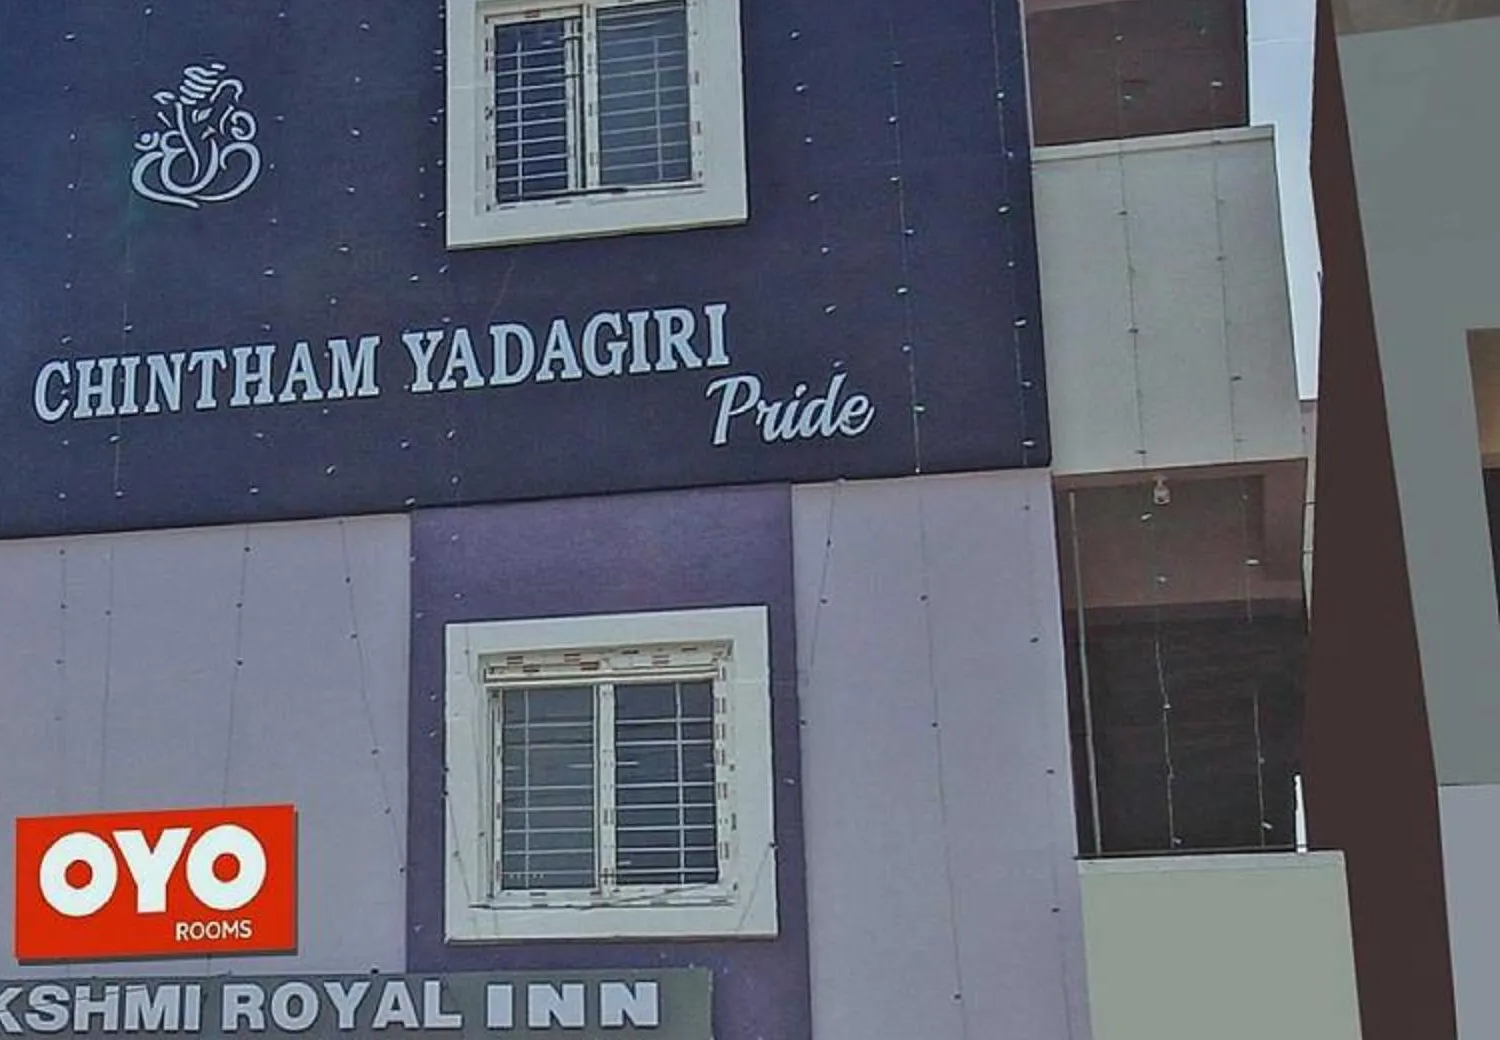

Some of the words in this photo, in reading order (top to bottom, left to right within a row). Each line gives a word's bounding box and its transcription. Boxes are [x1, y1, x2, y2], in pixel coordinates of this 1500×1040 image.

[34, 335, 381, 422] CHINTHAM
[403, 303, 730, 393] YADAGIRI
[705, 371, 875, 446] Pride
[38, 823, 268, 917] OYO
[175, 919, 253, 941] ROOMS
[222, 981, 462, 1033] ROYAL
[485, 980, 660, 1029] INN
